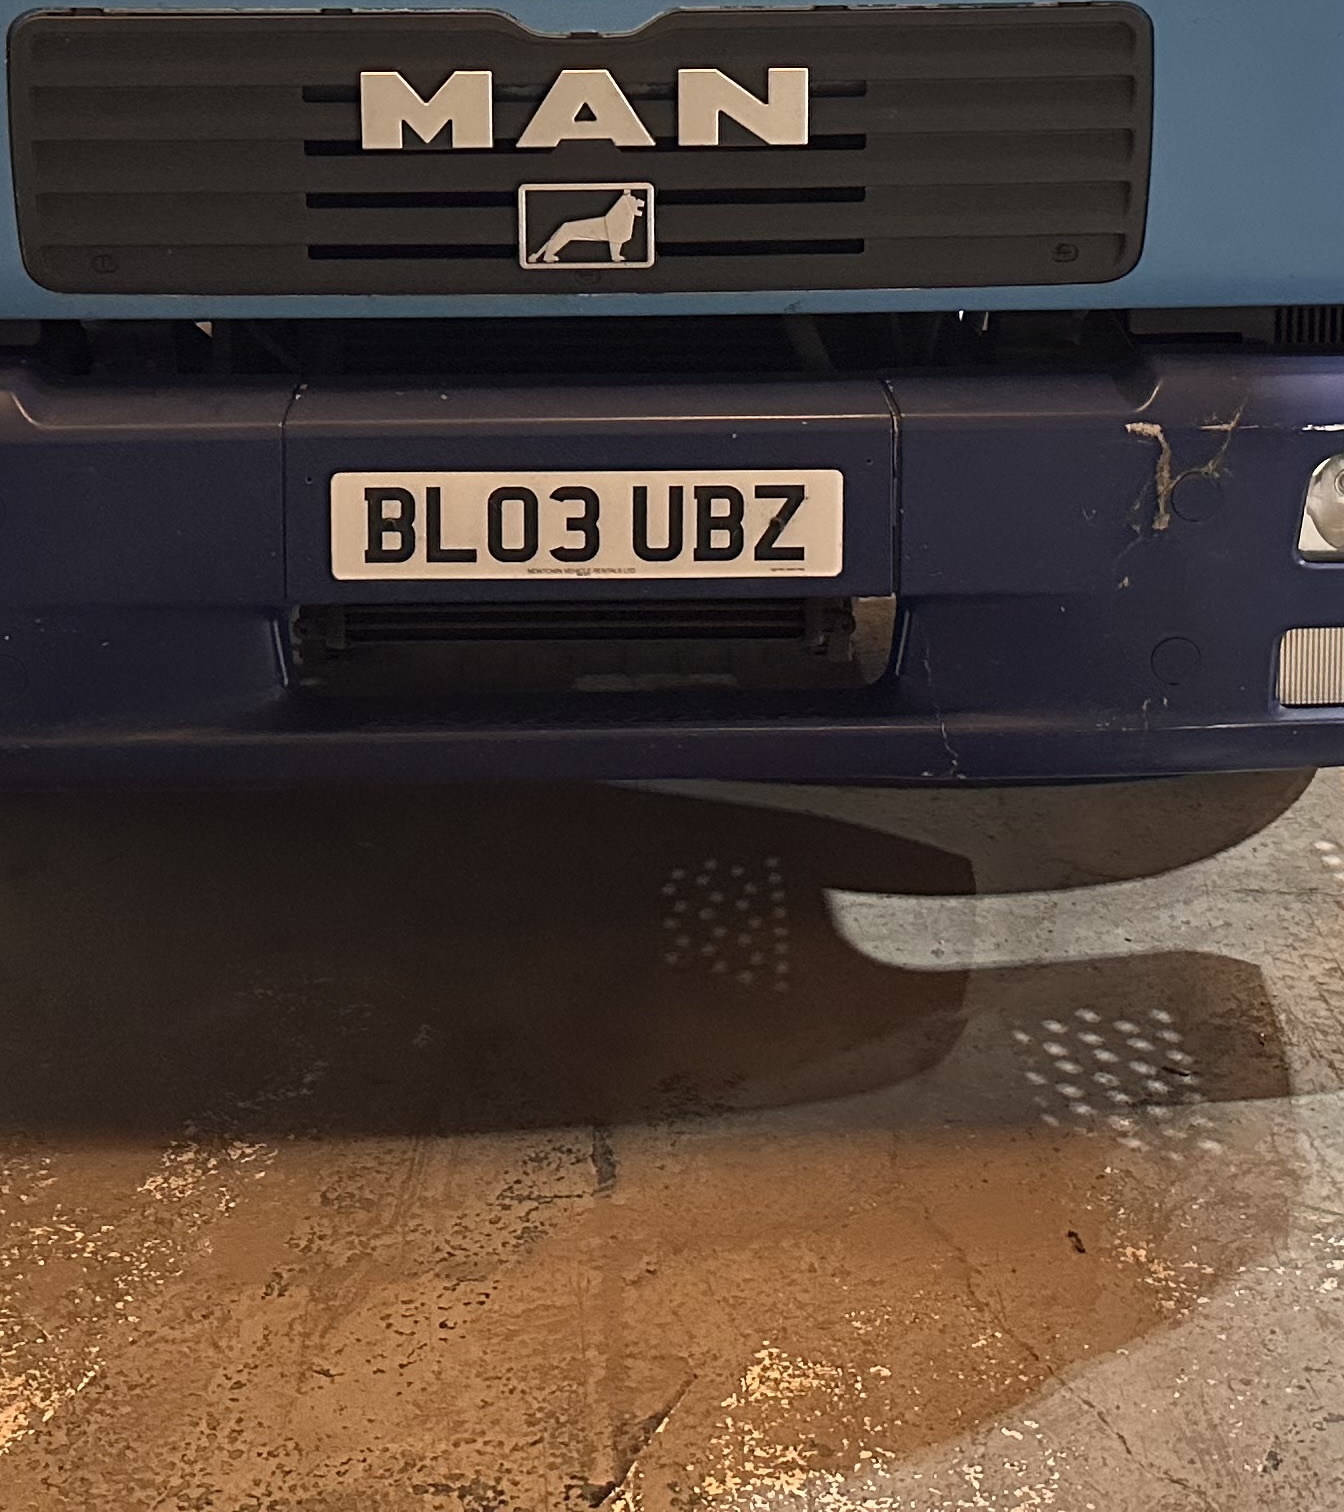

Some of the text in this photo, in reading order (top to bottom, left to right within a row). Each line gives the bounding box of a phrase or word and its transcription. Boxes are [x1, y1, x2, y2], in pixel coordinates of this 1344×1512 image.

[360, 67, 809, 149] MAN
[364, 484, 805, 564] BL03 UBZ
